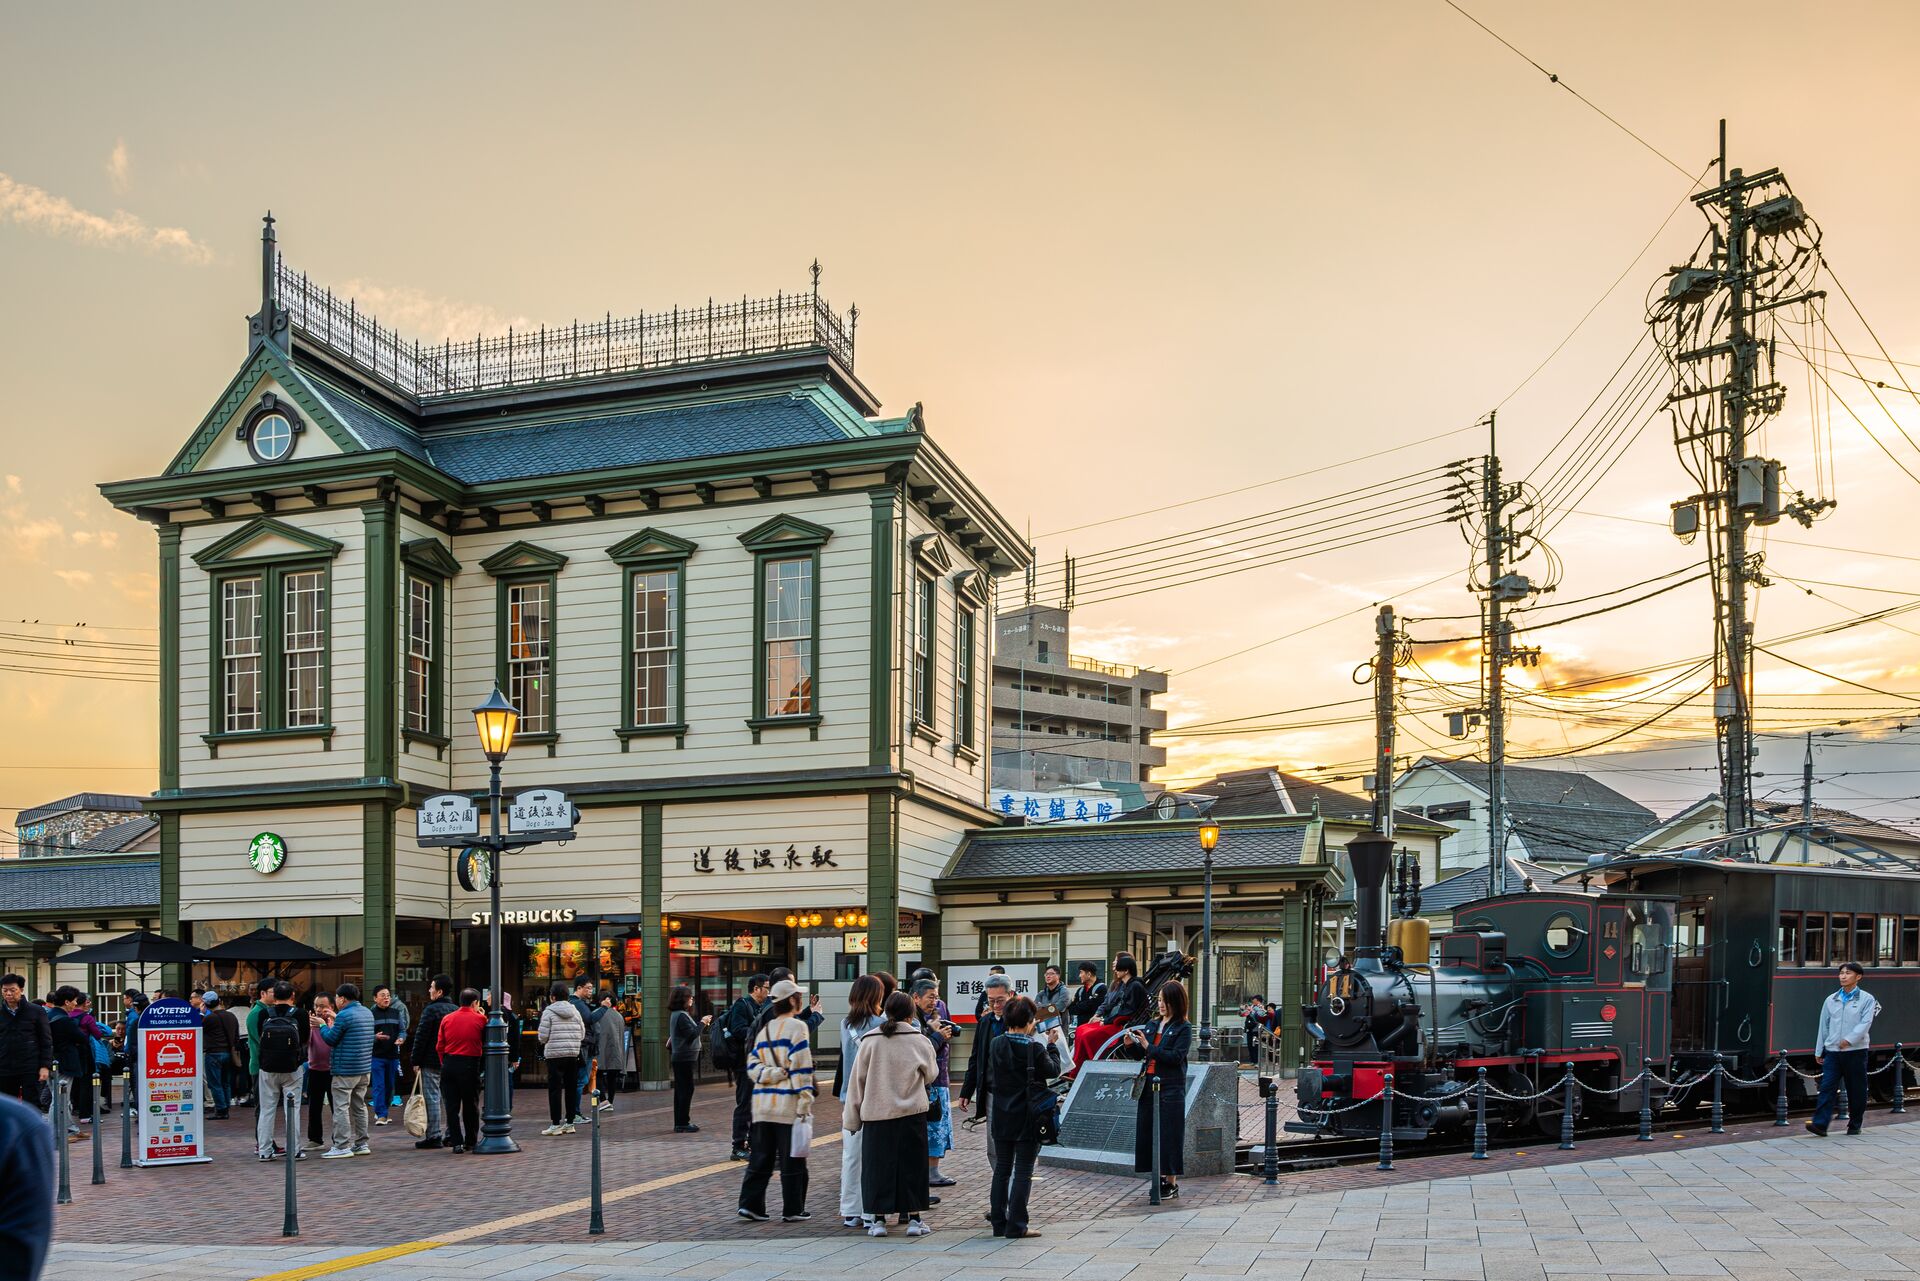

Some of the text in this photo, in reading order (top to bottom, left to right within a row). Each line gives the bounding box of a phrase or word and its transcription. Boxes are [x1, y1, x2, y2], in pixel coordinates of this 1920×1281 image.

[514, 803, 568, 819] 道後温泉
[999, 794, 1113, 822] 重松鍼灸院
[422, 809, 473, 824] 道後公園
[544, 819, 555, 827] Spa
[693, 844, 838, 873] 道後温泉駅
[1603, 921, 1618, 938] 14
[956, 979, 1029, 995] 道後駅
[1327, 975, 1352, 998] 14
[149, 1006, 191, 1014] IYOTETSU
[148, 1032, 193, 1041] IYOTETSU
[149, 1067, 193, 1075] タクシーのりば
